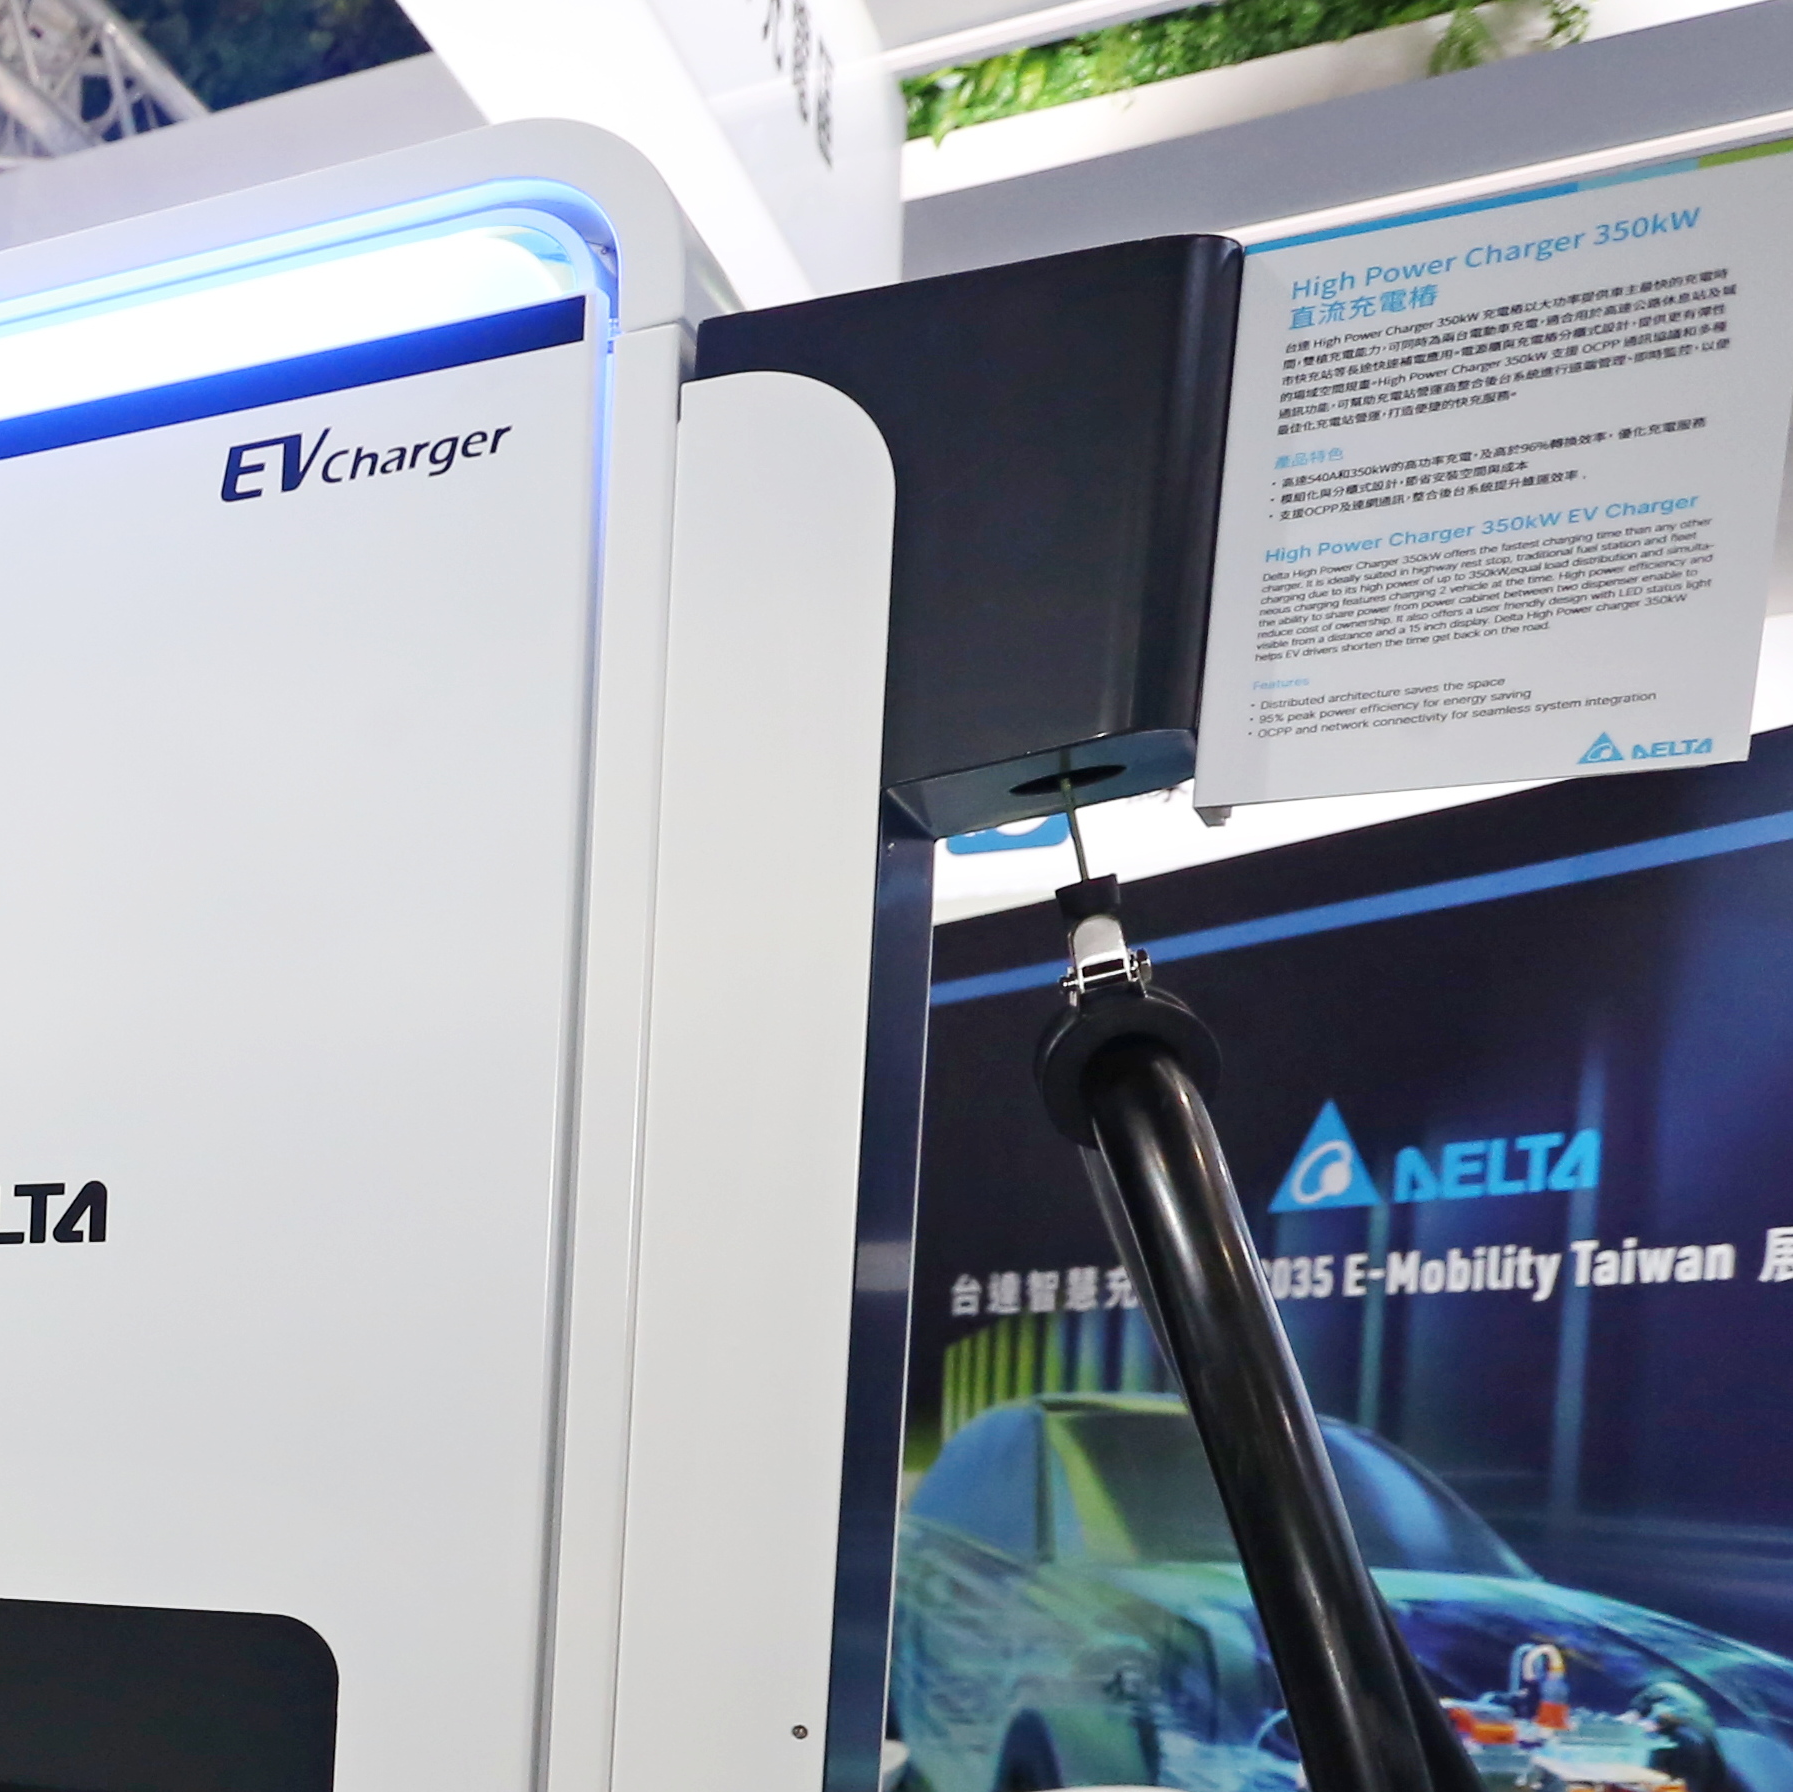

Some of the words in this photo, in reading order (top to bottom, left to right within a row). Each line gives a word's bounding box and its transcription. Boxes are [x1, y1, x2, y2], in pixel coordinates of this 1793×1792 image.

[1291, 271, 1355, 299] High
[1365, 256, 1457, 286] Power
[1464, 232, 1585, 267] Charger
[1593, 207, 1700, 245] 350kW
[1265, 545, 1311, 563] High
[1317, 537, 1382, 555] Power
[1388, 526, 1474, 546] Charger
[1481, 511, 1561, 534] 350kW
[1567, 506, 1598, 523] EV
[1605, 496, 1698, 518] Charger
[1257, 726, 1292, 738] OCPP
[1295, 723, 1317, 734] and
[1320, 719, 1369, 731] network
[1372, 712, 1448, 727] connectivity
[1451, 709, 1468, 719] for
[1471, 704, 1531, 717] seamless
[1534, 699, 1581, 713] system
[1584, 692, 1656, 706] integration
[1259, 713, 1284, 724] 95%
[1286, 709, 1315, 723] peak
[1318, 707, 1357, 719] power
[1359, 701, 1419, 714] efficiency
[1422, 698, 1440, 707] for
[1442, 694, 1487, 705] energy
[1490, 690, 1531, 701] saving
[1260, 694, 1325, 710] Distributed
[1327, 688, 1401, 703] architecture
[1404, 684, 1439, 695] saves
[1443, 681, 1464, 691] the
[1466, 678, 1505, 690] space
[1630, 737, 1713, 759] DELTA
[1394, 1127, 1603, 1204] DELTA
[1343, 1241, 1562, 1302] E-Mobility
[1570, 1237, 1737, 1289] Taiwan
